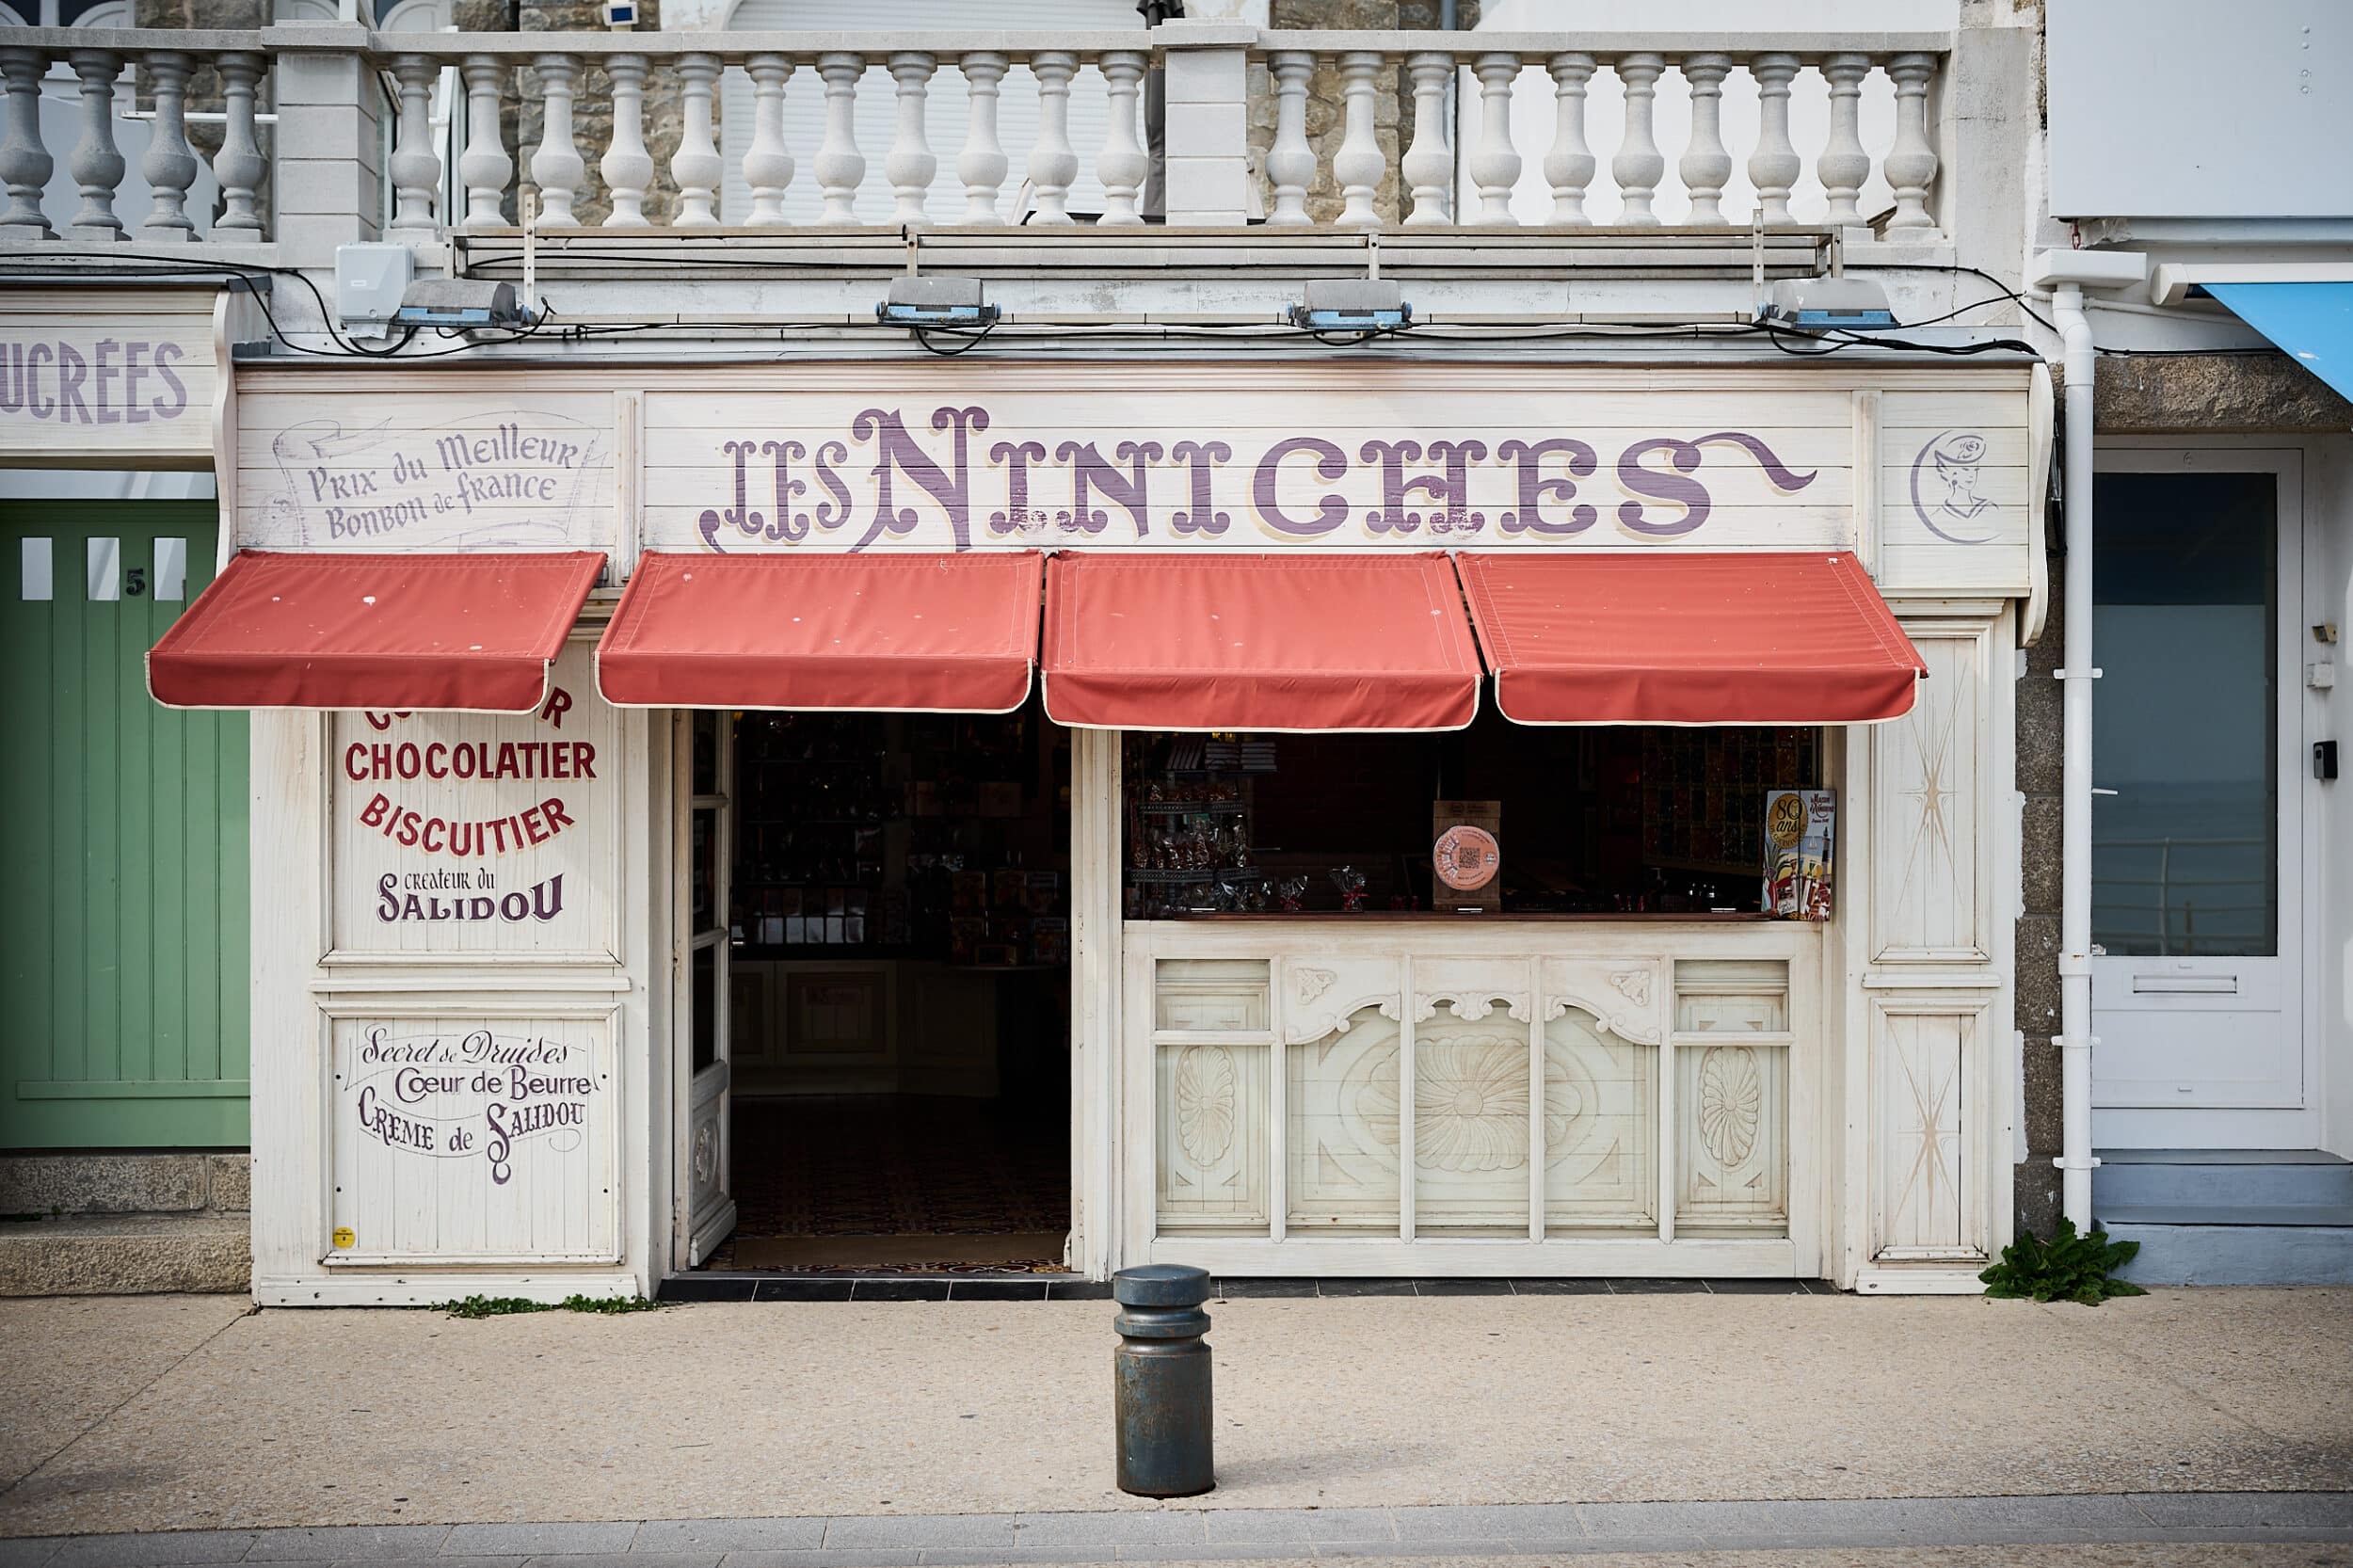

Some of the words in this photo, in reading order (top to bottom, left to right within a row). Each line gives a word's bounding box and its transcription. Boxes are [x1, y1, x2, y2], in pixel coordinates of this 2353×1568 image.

[393, 452, 427, 484] du
[724, 440, 853, 542] LES
[853, 407, 1817, 552] NINICHES
[433, 492, 455, 514] de
[126, 568, 146, 597] 5
[345, 742, 597, 780] CHOCOLATIER
[360, 792, 575, 856] BISCUITIER
[1777, 798, 1803, 821] 80
[1777, 820, 1799, 833] ans
[376, 872, 565, 922] SALIDOU
[478, 867, 495, 890] du
[362, 1024, 440, 1064] Secret
[460, 1030, 568, 1064] Druides
[471, 1070, 504, 1094] de
[505, 1064, 592, 1101] Beurre
[358, 1085, 435, 1150] CREME
[449, 1127, 473, 1152] de
[487, 1102, 585, 1185] SALIDOU
